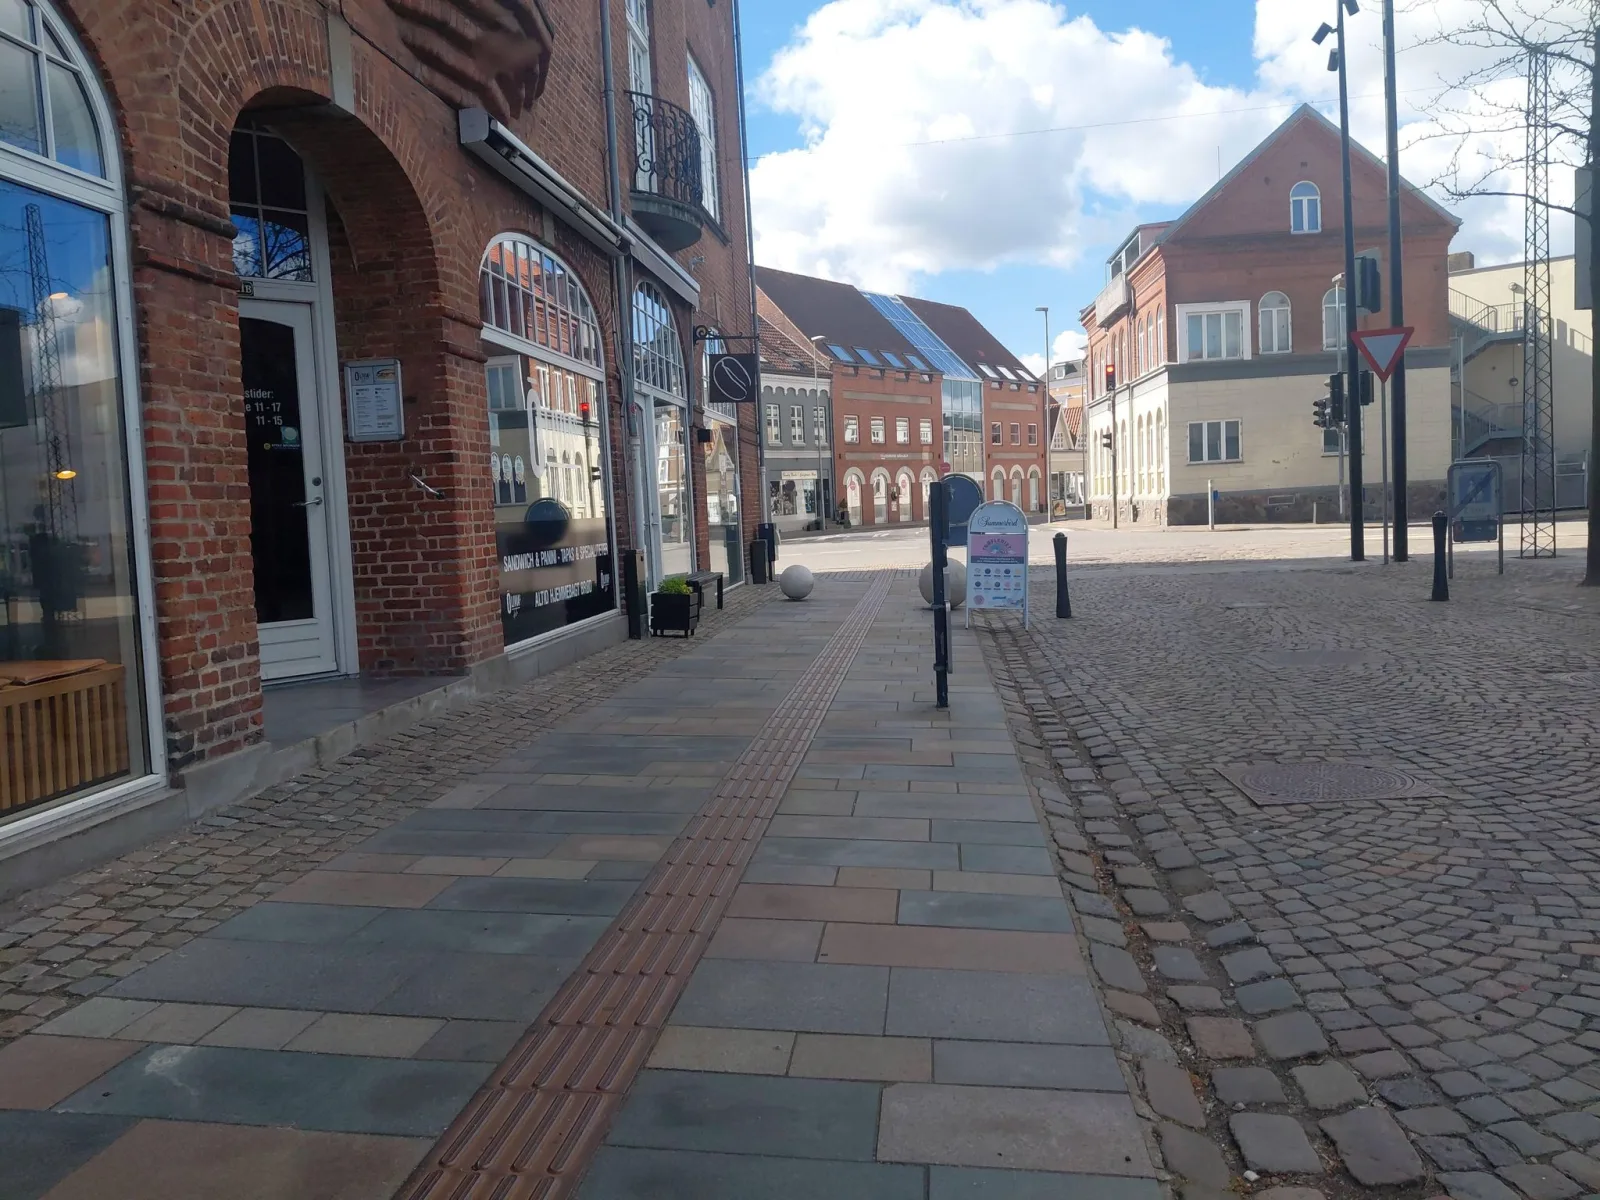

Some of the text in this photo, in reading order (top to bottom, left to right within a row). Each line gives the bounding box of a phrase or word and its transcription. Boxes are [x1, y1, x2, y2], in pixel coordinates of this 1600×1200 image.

[254, 402, 264, 412] 11
[271, 402, 281, 412] 17
[256, 415, 264, 425] 11
[272, 415, 282, 425] 15
[503, 552, 535, 572] SANDWICH
[536, 553, 540, 567] &
[540, 549, 557, 566] PANINI
[560, 547, 575, 563] TAPAS
[534, 590, 549, 608] ALTID
